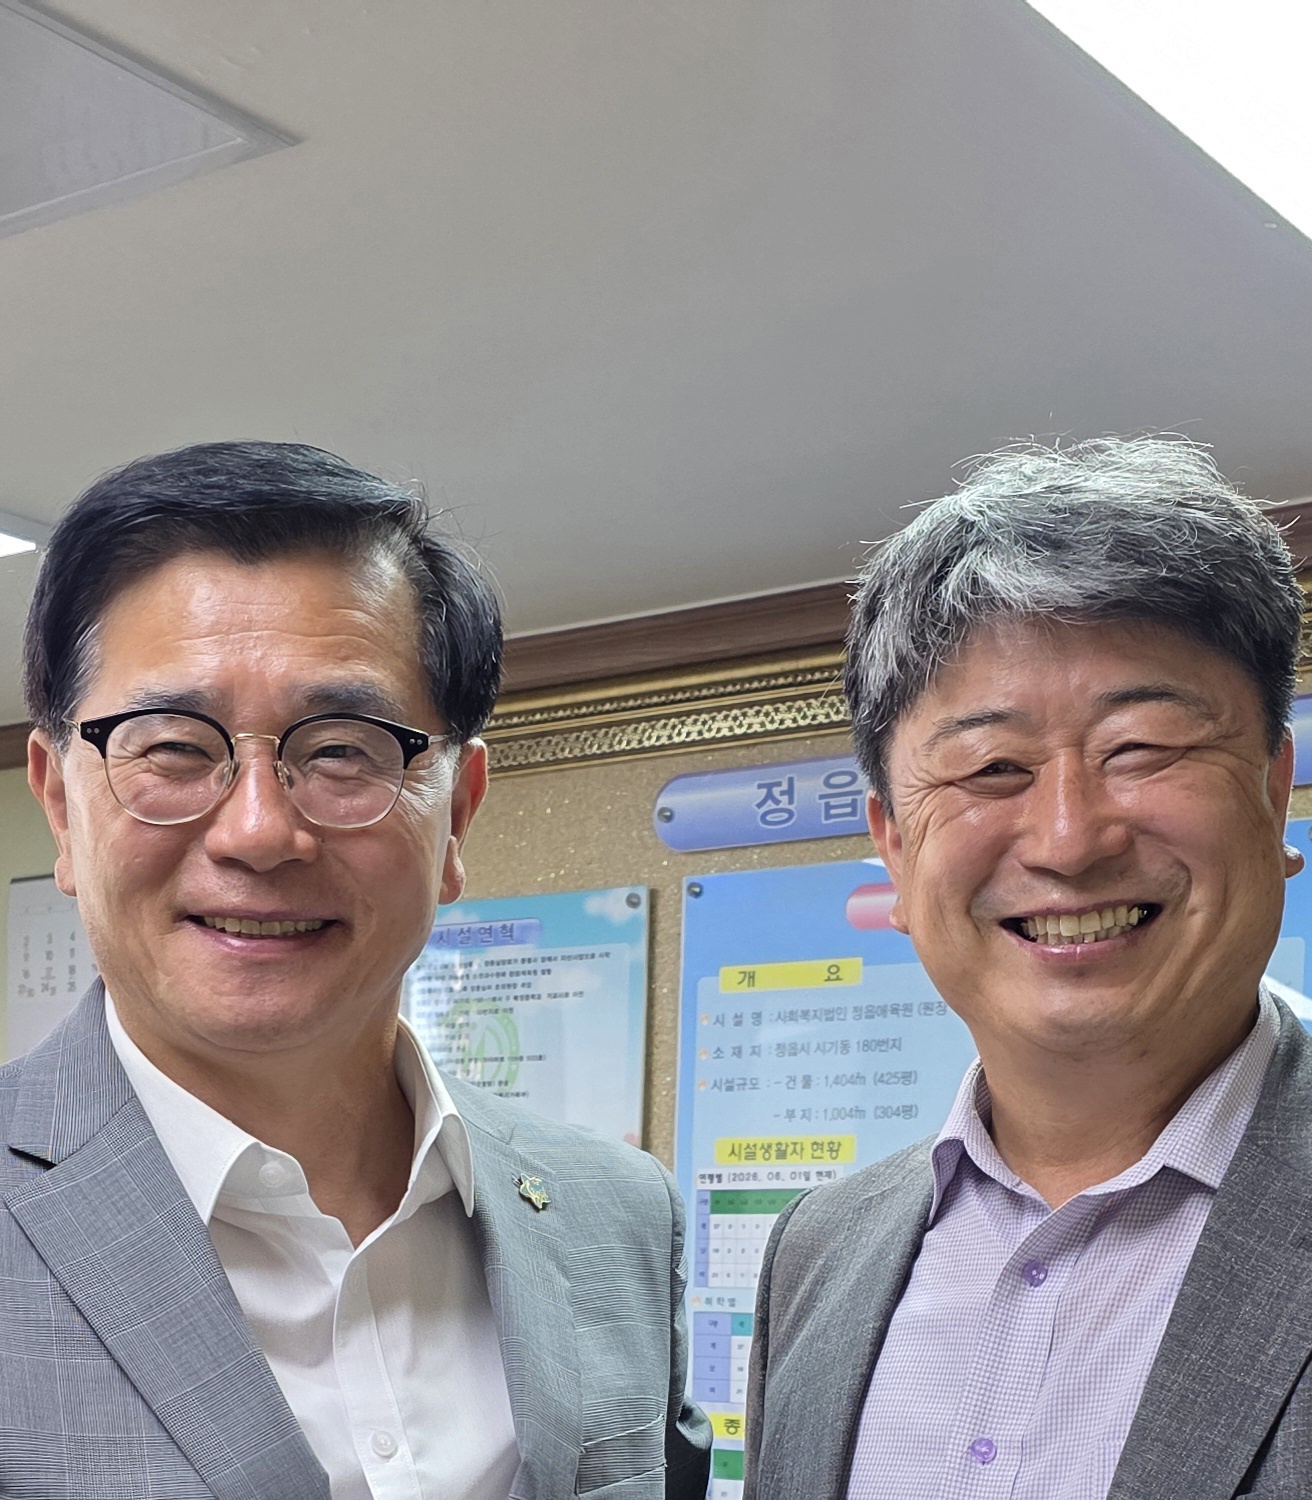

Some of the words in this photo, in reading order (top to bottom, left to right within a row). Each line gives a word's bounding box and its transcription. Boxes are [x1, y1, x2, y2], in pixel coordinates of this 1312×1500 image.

[438, 923, 515, 945] 시설연혁
[814, 1039, 851, 1056] 시기동
[856, 1037, 903, 1053] 180번지
[728, 1141, 805, 1161] 시설생활자
[810, 1140, 842, 1160] 현황
